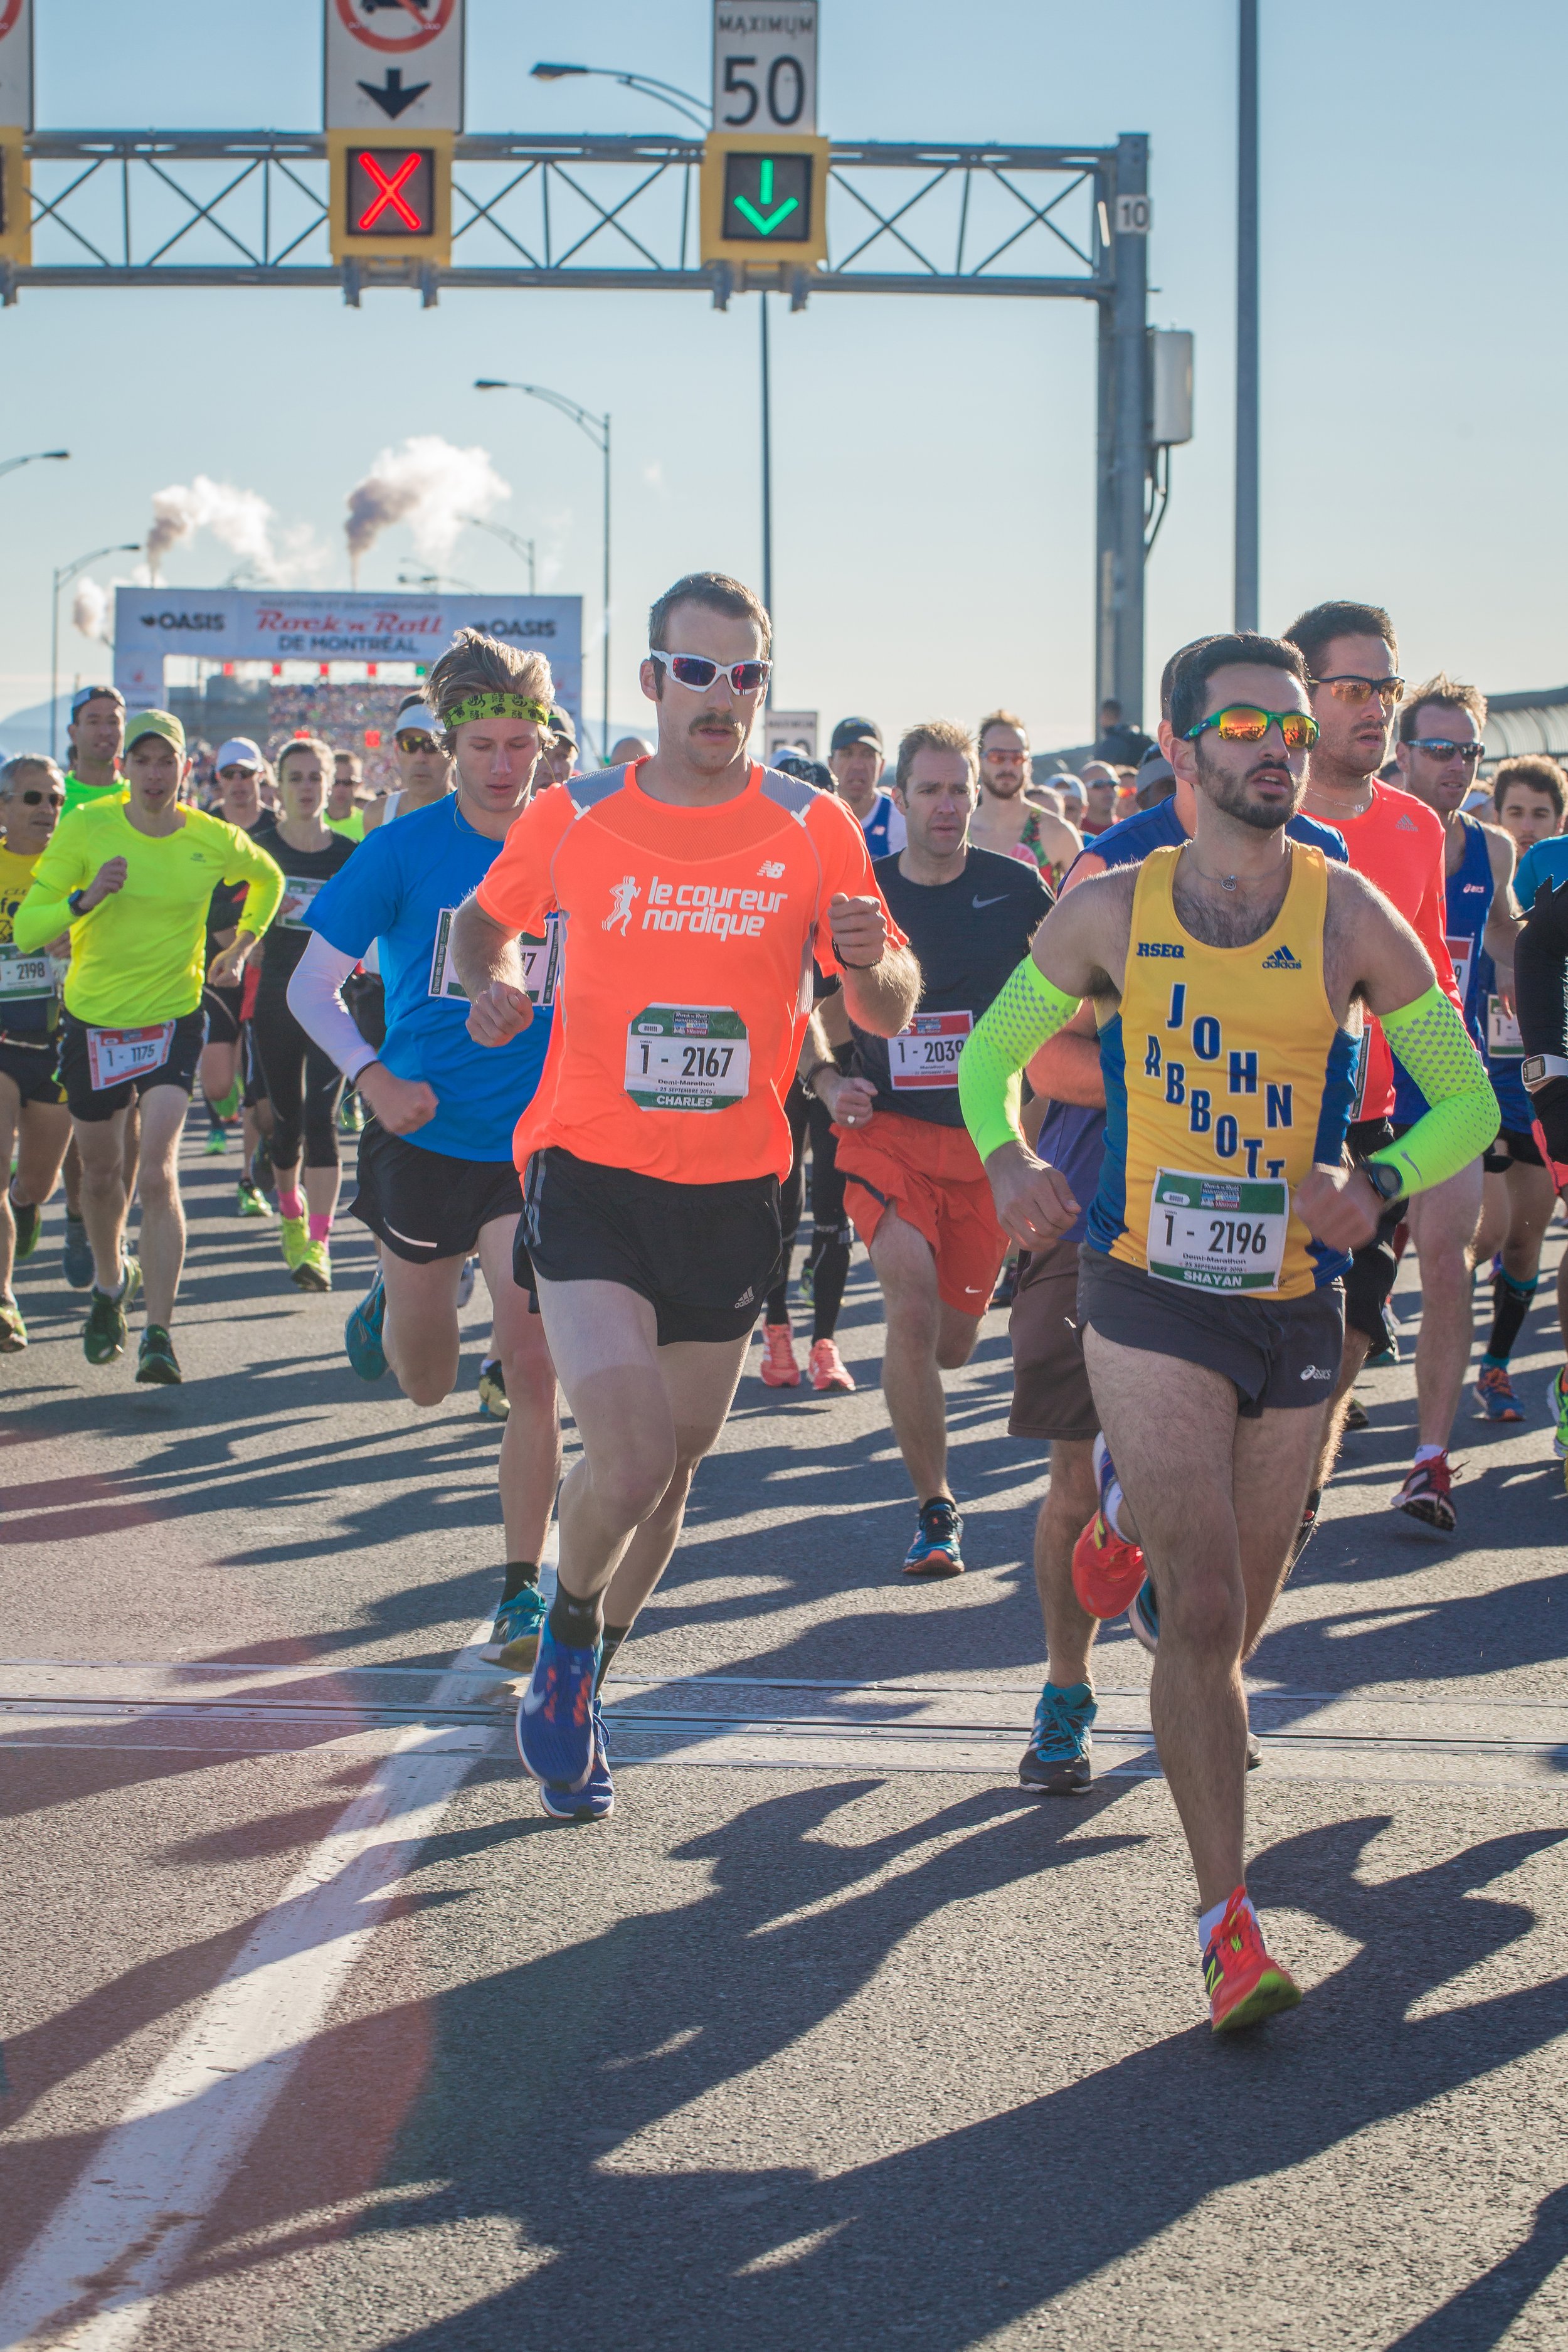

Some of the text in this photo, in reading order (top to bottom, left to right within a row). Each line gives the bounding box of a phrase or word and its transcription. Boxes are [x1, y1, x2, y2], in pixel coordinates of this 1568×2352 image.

[719, 16, 813, 32] MAXIMUM
[724, 54, 805, 126] 50
[1122, 201, 1149, 227] 10
[159, 612, 225, 631] OASIS
[255, 608, 342, 632] Rock
[372, 610, 443, 635] Roll
[490, 618, 557, 637] OASIS
[278, 633, 305, 652] DE
[1396, 824, 1418, 832] adidas
[648, 876, 788, 914] le coureur
[642, 907, 765, 942] nordique
[1136, 942, 1186, 959] RSEQ
[16, 961, 45, 980] 2198
[1262, 960, 1302, 970] adidas
[107, 1050, 113, 1067] 1
[132, 1044, 156, 1062] 1175
[641, 1044, 650, 1074] 1
[681, 1047, 734, 1078] 2167
[898, 1042, 905, 1063] 1
[658, 1079, 715, 1087] Demi-Marathon
[656, 1094, 713, 1107] CHARLES
[1165, 1214, 1173, 1246] 1
[1208, 1221, 1266, 1254] 2196
[1183, 1253, 1246, 1264] Demi-Marathon
[1184, 1270, 1242, 1286] SHAYAN
[734, 1295, 755, 1308] adidas
